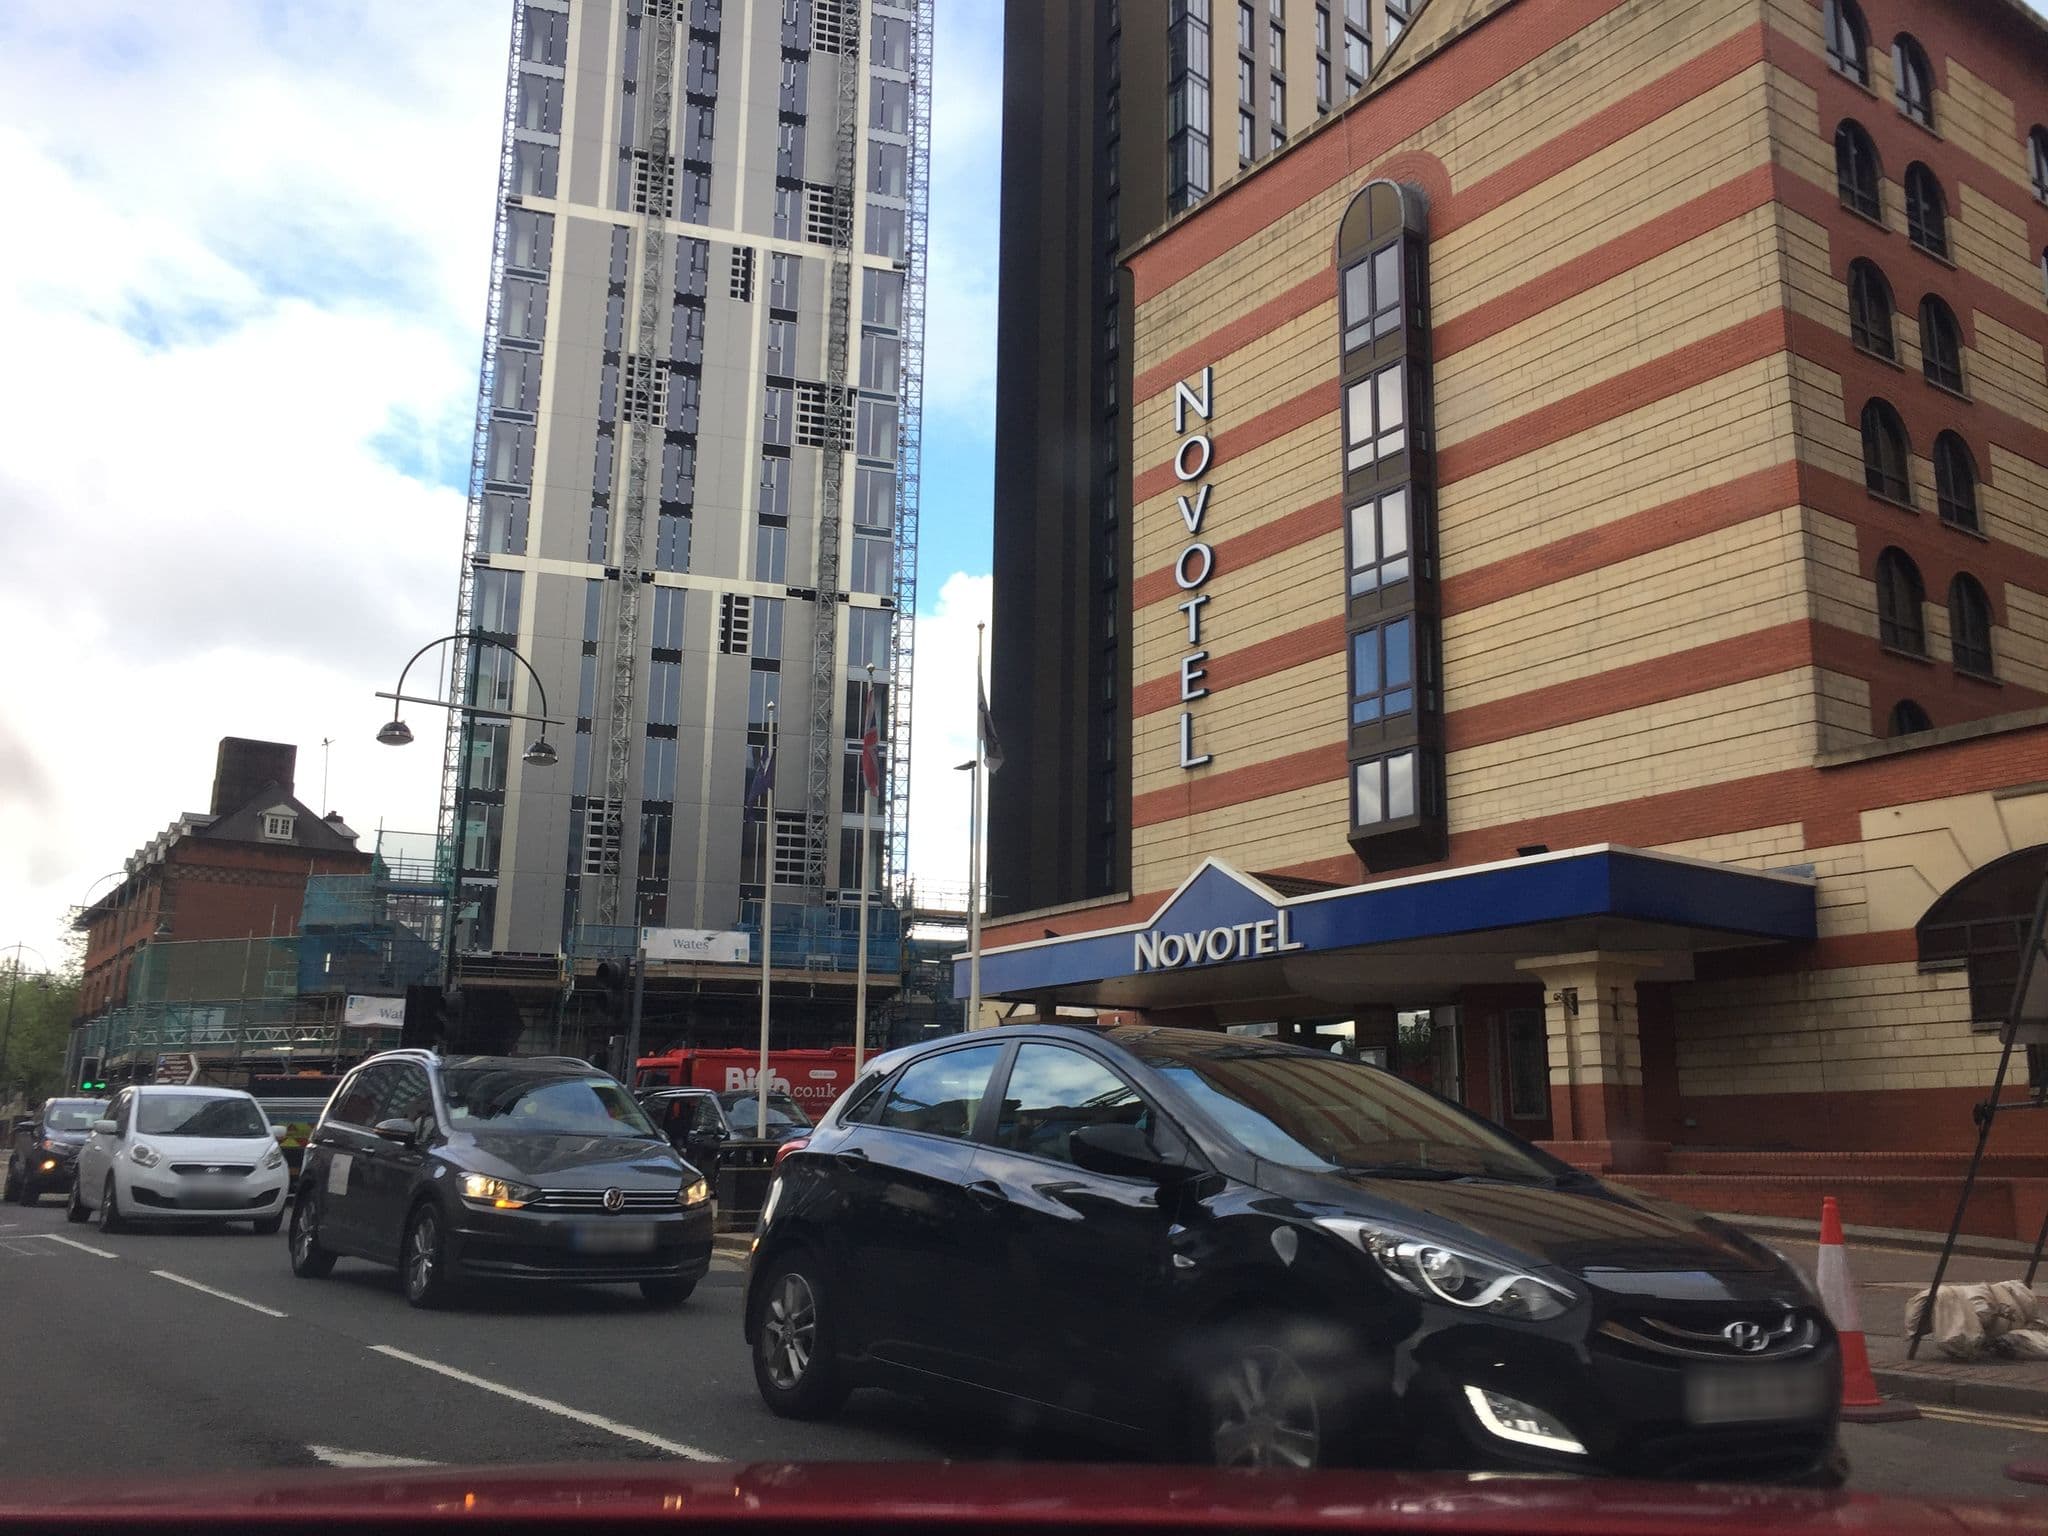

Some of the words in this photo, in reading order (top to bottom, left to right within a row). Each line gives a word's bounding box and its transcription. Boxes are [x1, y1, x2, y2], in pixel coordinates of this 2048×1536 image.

[1174, 366, 1214, 769] NOVOTEL
[672, 938, 710, 951] Wates
[1134, 909, 1304, 971] NOVOTEL
